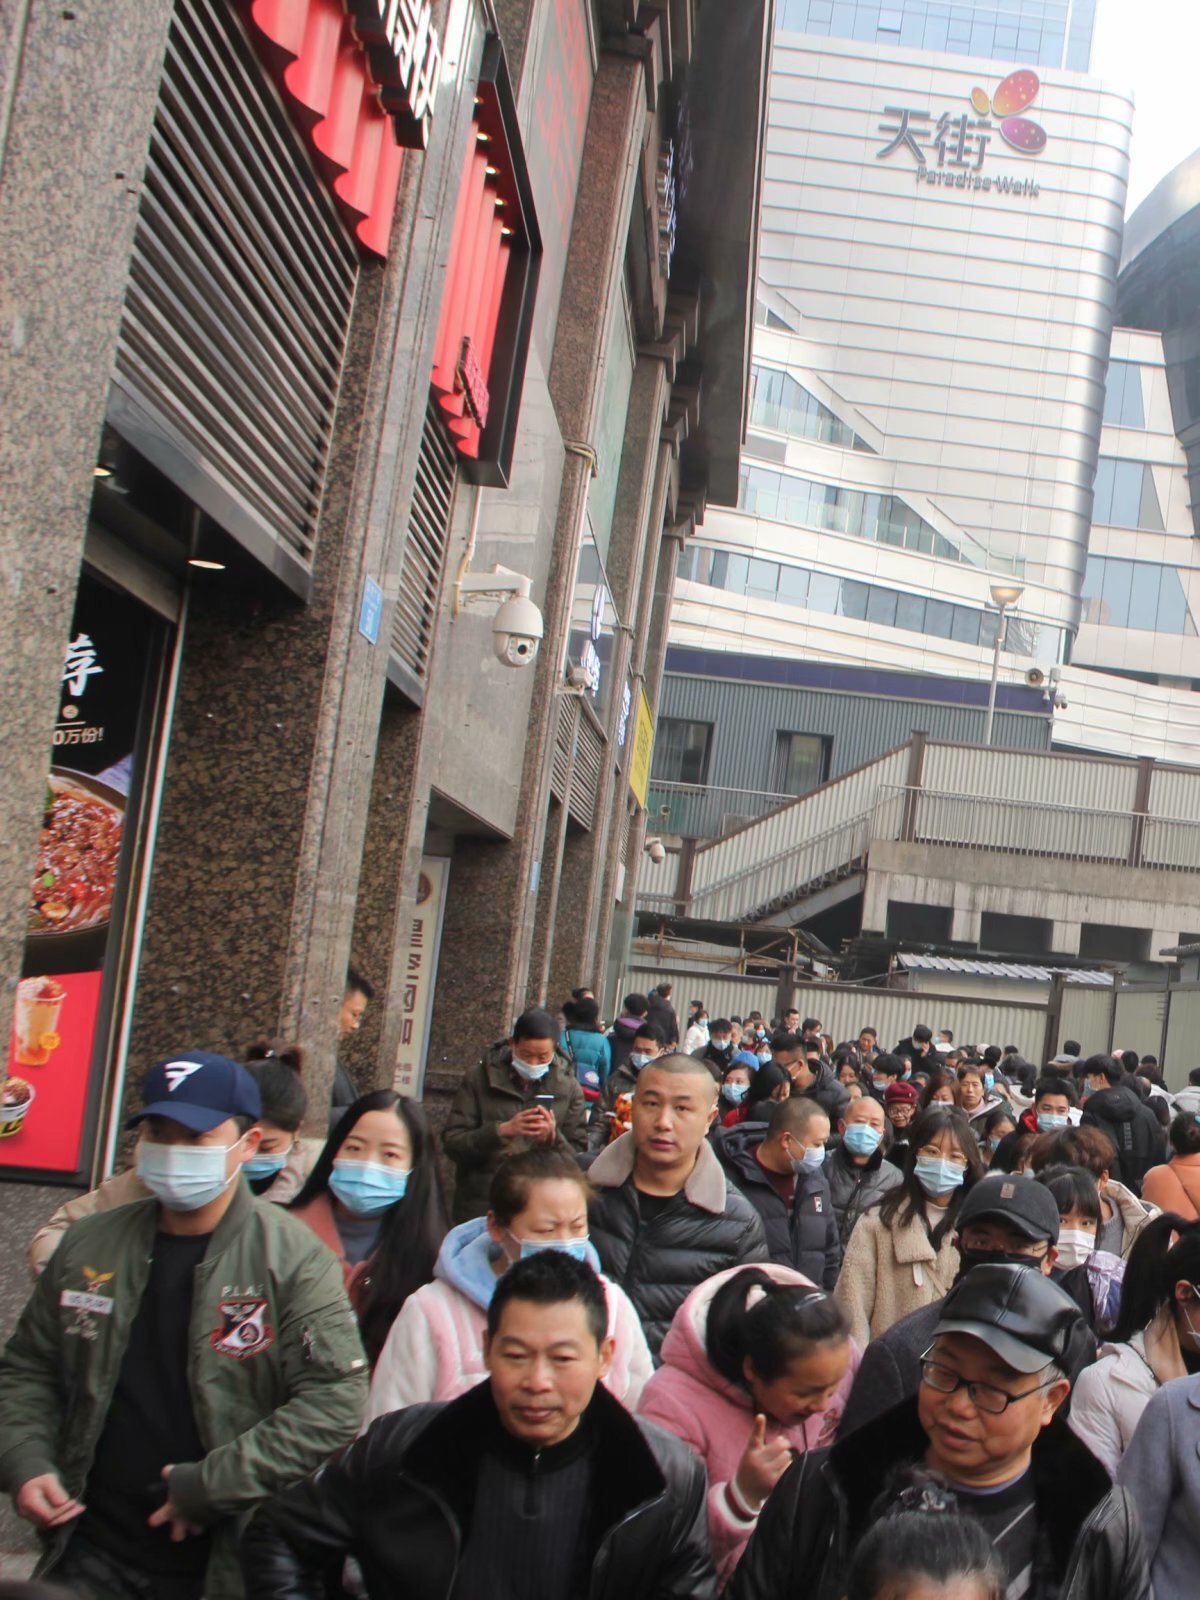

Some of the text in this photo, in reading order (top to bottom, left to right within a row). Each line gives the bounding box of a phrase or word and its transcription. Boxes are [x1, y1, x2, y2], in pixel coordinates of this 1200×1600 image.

[876, 105, 992, 170] 天街
[916, 165, 1042, 199] Paradise Walk
